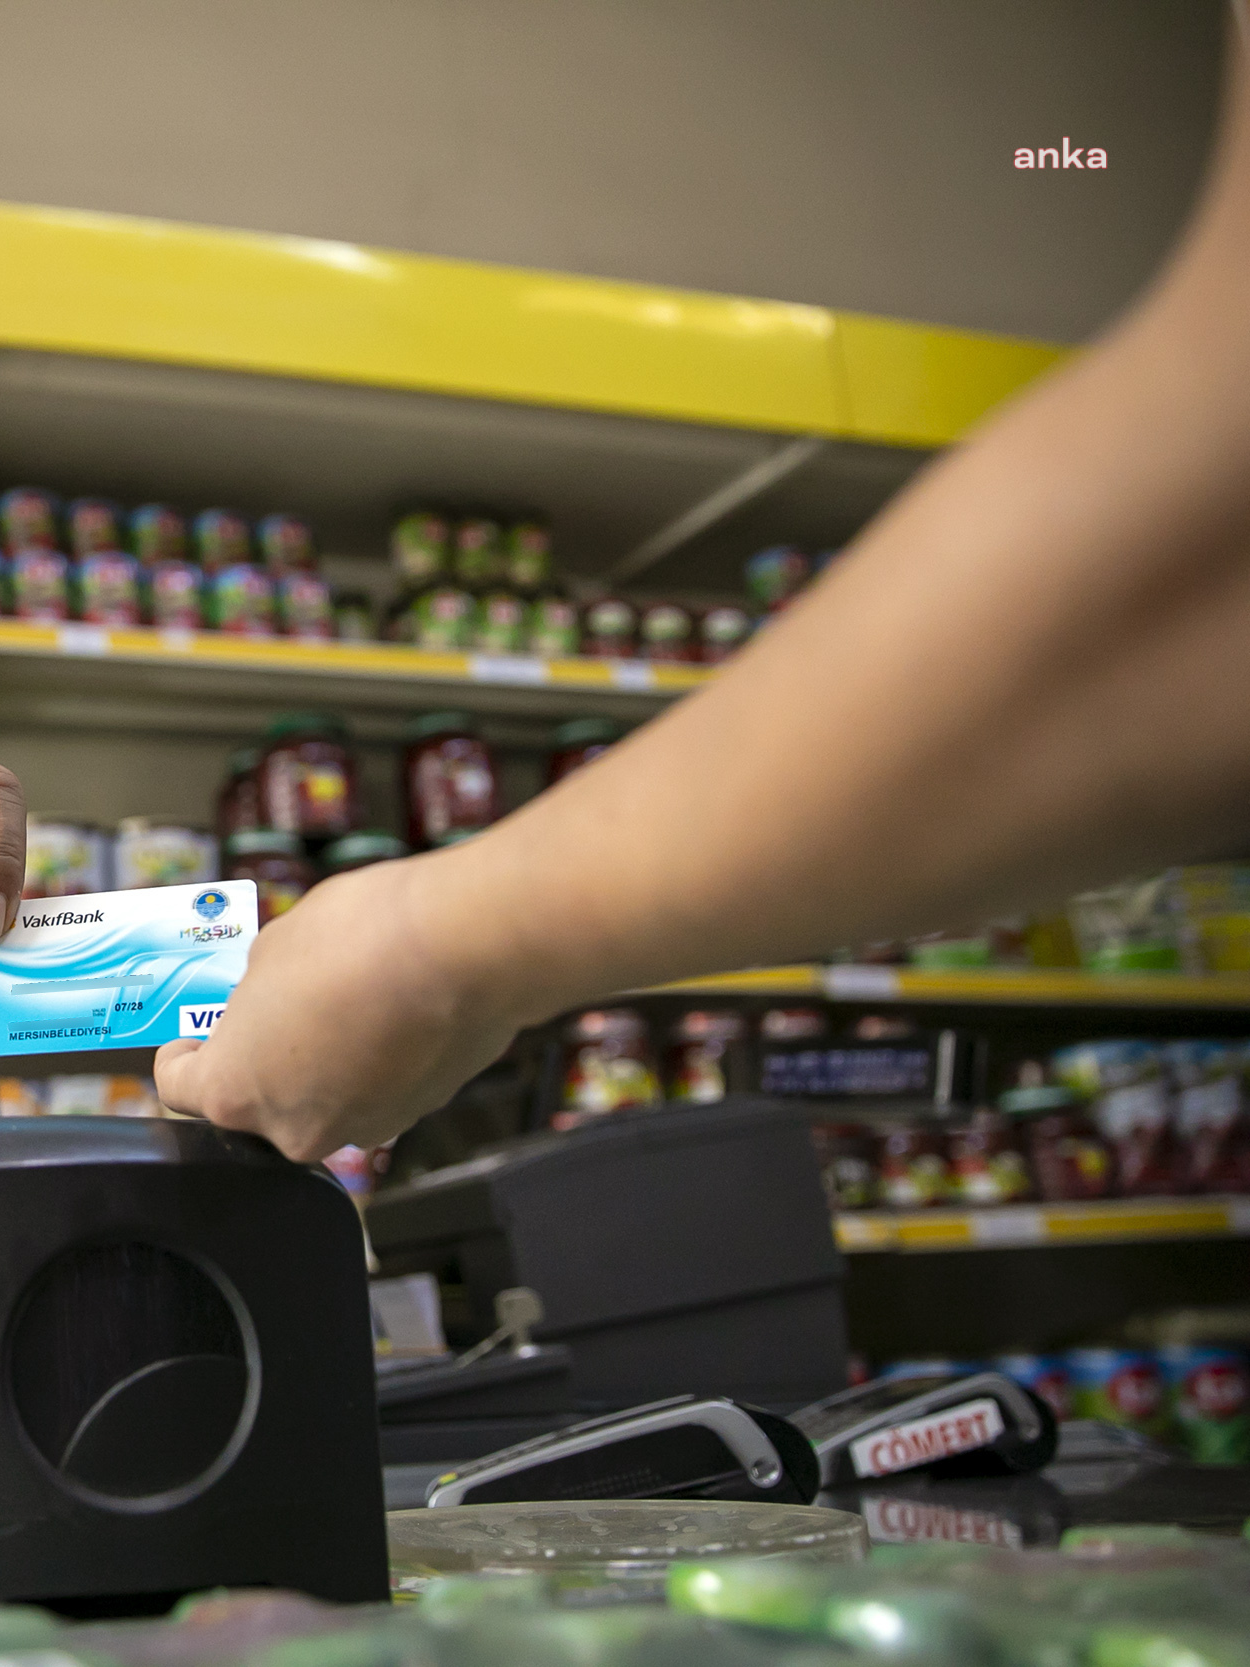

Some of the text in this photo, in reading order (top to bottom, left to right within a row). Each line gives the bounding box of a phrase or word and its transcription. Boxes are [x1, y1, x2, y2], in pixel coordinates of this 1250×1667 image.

[22, 909, 105, 929] VakıfBank
[114, 1001, 144, 1012] 07/28
[9, 1026, 112, 1041] MERSINBELEDIYESI
[869, 1410, 989, 1474] CÖMERT
